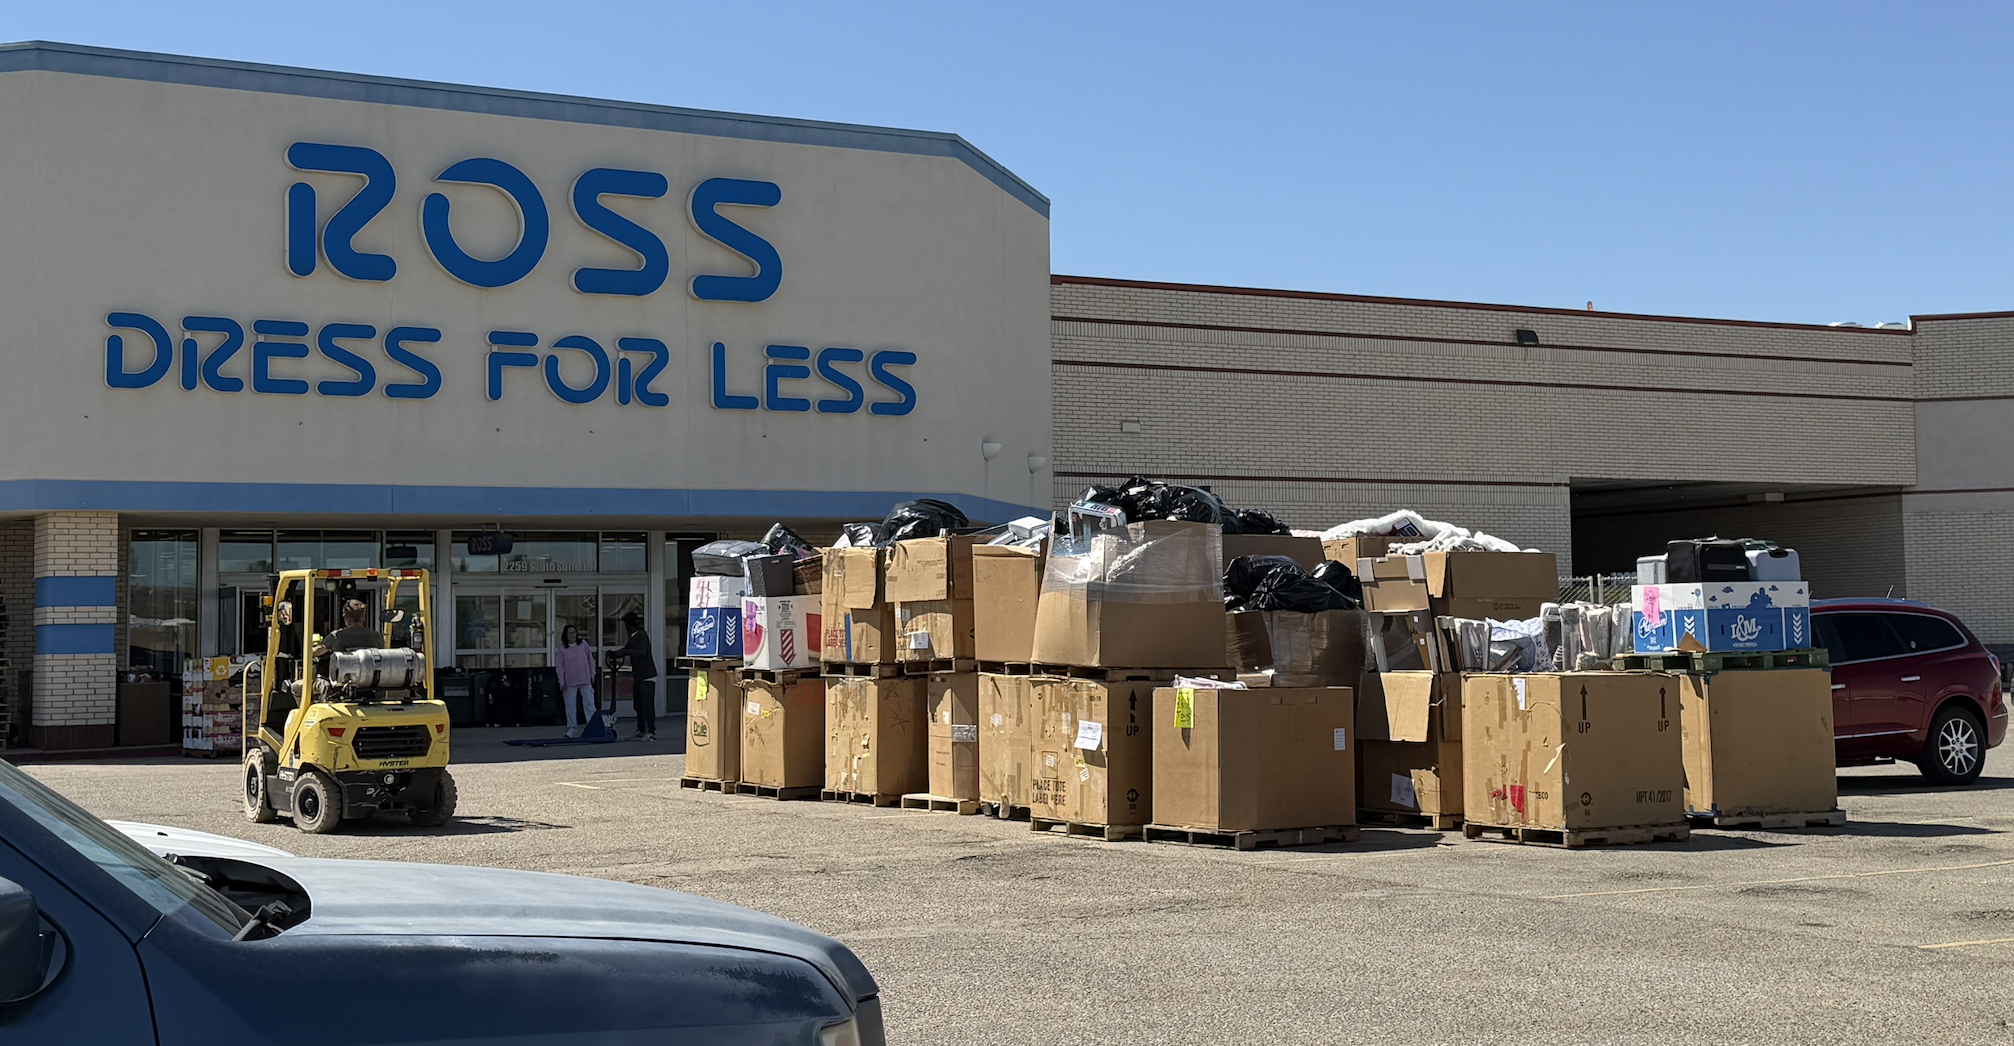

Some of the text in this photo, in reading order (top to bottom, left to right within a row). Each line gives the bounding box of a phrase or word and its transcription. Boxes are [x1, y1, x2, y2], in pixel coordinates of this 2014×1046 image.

[284, 141, 783, 303] ROSS
[104, 311, 918, 417] DRESS FOR LESS
[471, 536, 492, 551] ROSS
[504, 561, 528, 572] 2259
[1126, 726, 1140, 736] UP
[1578, 722, 1591, 733] UP
[1657, 720, 1670, 732] UP
[1032, 779, 1066, 792] PLACE TOTE
